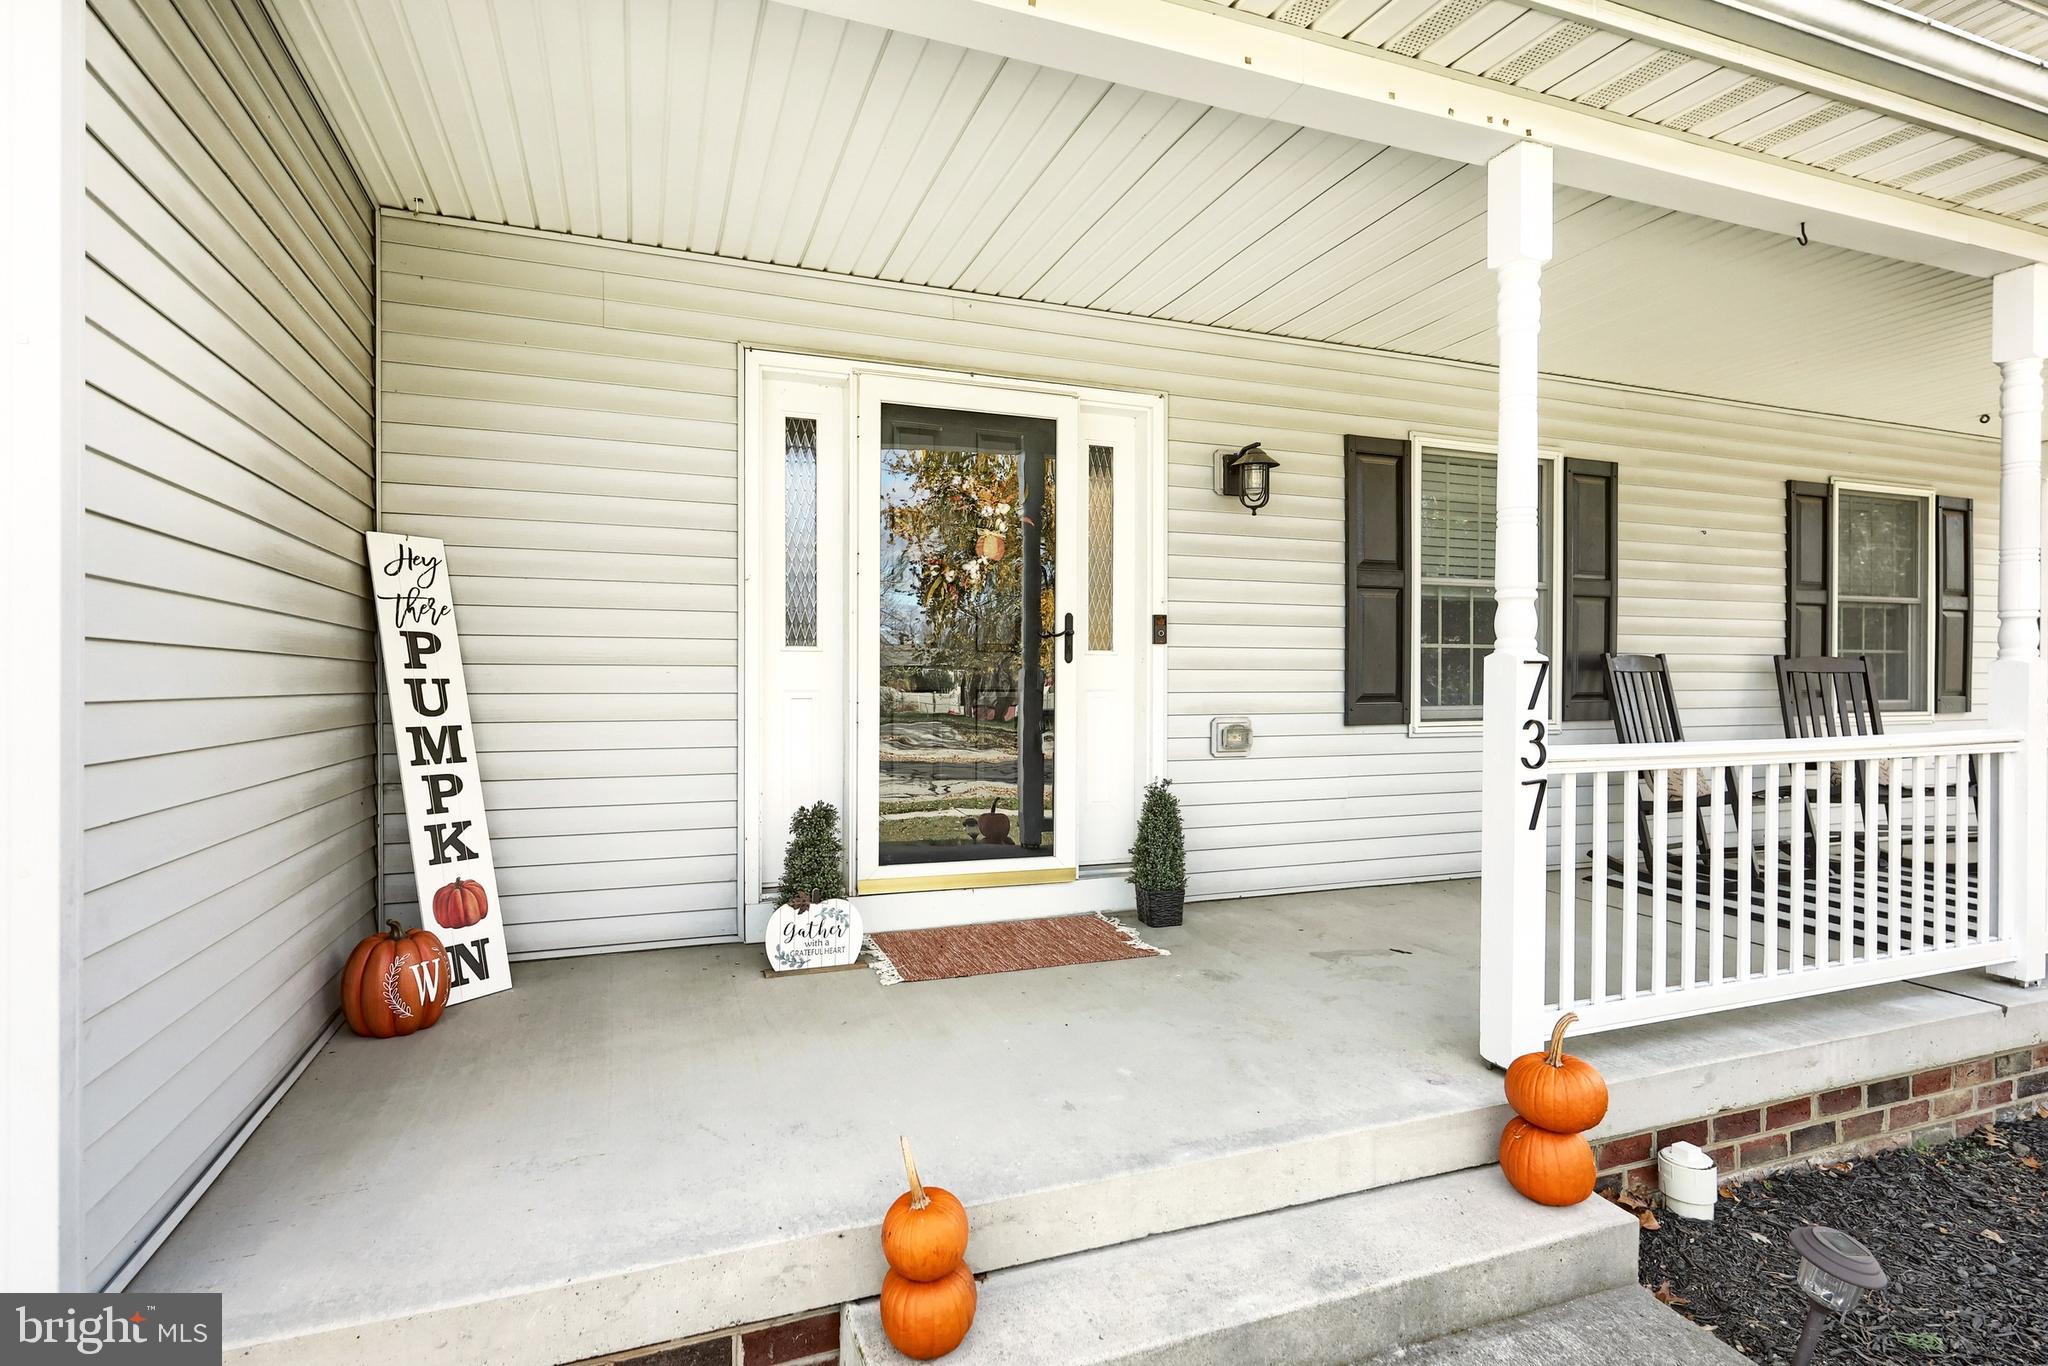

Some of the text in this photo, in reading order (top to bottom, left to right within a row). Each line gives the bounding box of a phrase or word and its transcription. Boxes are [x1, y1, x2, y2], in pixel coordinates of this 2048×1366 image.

[384, 543, 442, 589] Hey
[377, 587, 451, 628] there
[1520, 660, 1549, 830] 737
[783, 919, 849, 944] Gather
[790, 946, 846, 958] GRATEFUL HEART
[804, 939, 823, 948] with
[409, 958, 440, 1006] W
